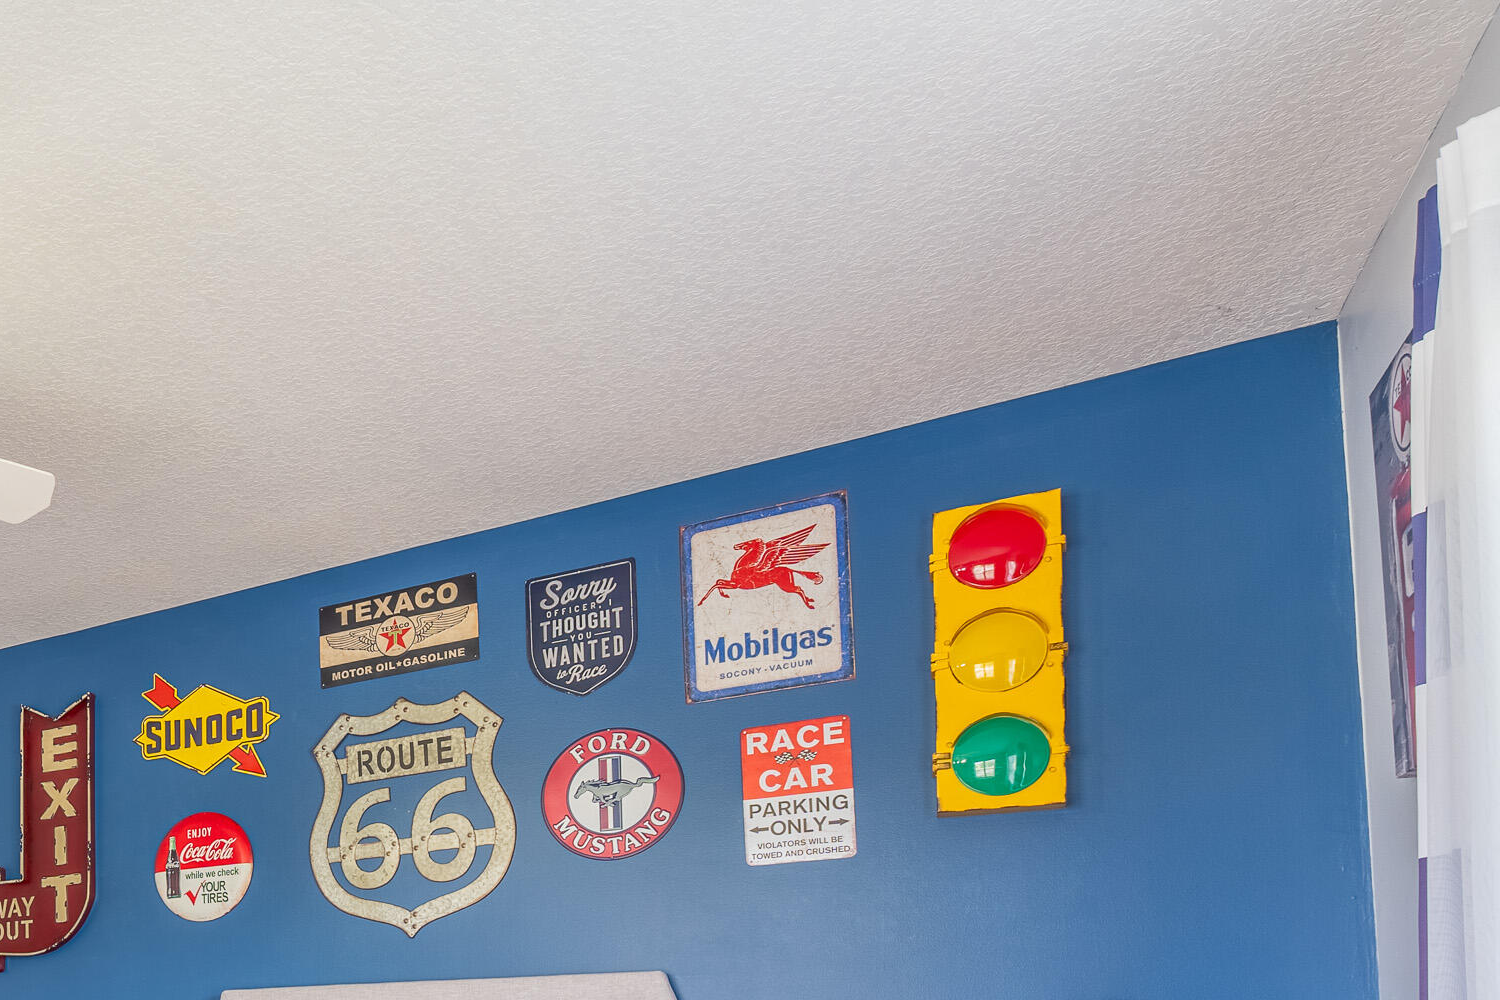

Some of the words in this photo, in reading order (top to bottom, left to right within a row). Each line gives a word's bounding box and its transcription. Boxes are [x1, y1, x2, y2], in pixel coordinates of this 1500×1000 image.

[335, 582, 459, 626] TEXACO
[540, 577, 617, 610] Sorry
[608, 599, 612, 607] I
[381, 621, 410, 632] TEXACO
[540, 606, 623, 643] THOUGHT
[569, 631, 592, 642] YOU
[542, 635, 624, 669] WANTED
[704, 626, 833, 666] Mobilgas
[332, 666, 373, 681] MOTOR
[376, 661, 397, 673] OIL
[403, 647, 466, 668] GASOLINE
[556, 669, 568, 680] to
[565, 664, 608, 685] Race
[146, 701, 264, 755] SUNOCO
[746, 721, 845, 755] RACE
[357, 735, 454, 777] ROUTE
[569, 732, 651, 764] FORD
[758, 763, 834, 793] CAR
[749, 794, 849, 819] PARKING
[40, 723, 82, 923] EXIT
[187, 826, 212, 839] ENJOY
[339, 776, 477, 890] 66
[553, 808, 671, 854] MUSTANG
[770, 816, 827, 836] ONLY
[180, 837, 237, 864] Coca-Cola
[752, 851, 783, 860] TOWED
[785, 848, 804, 857] AND
[806, 845, 851, 855] CRUSHED
[757, 839, 806, 850] VIOLATORS
[809, 836, 829, 845] WILL
[831, 835, 844, 843] BE
[185, 870, 204, 880] while
[205, 870, 216, 878] we
[218, 867, 239, 877] check
[200, 880, 227, 892] YOUR
[201, 892, 229, 904] TIRES
